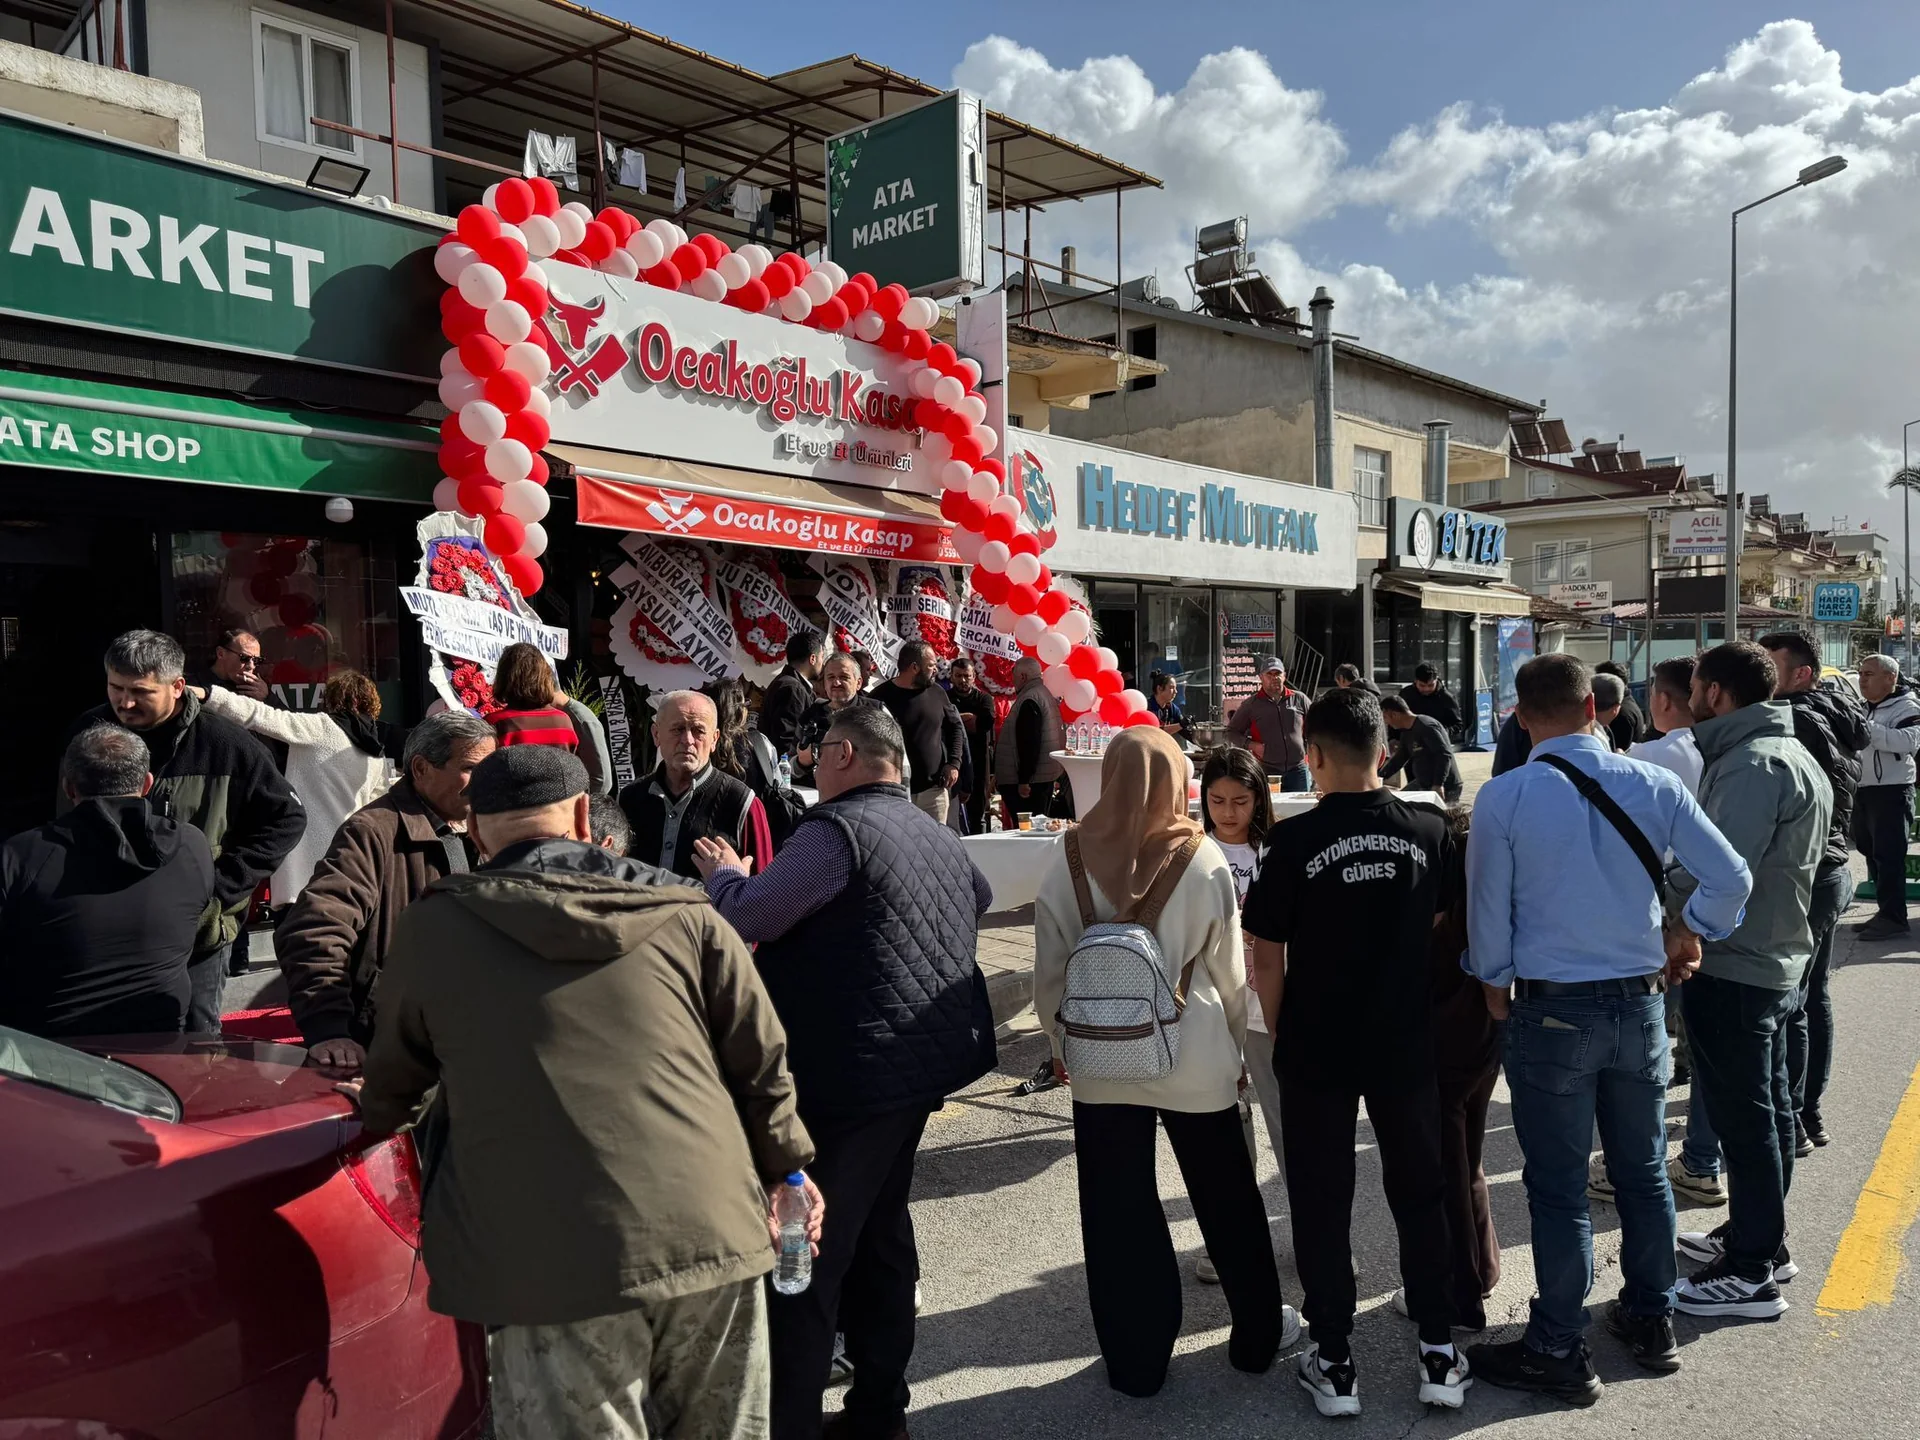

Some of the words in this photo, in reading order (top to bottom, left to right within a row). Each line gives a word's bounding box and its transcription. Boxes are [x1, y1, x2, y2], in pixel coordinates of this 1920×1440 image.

[873, 178, 915, 210] ATA
[9, 186, 325, 309] ARKET
[852, 203, 938, 249] MARKET
[638, 322, 834, 422] Ocakoğlu
[840, 369, 924, 450] Kasa
[0, 416, 79, 452] ATA
[91, 427, 201, 464] SHOP
[785, 432, 802, 453] Et
[809, 441, 827, 457] ve
[833, 442, 849, 461] Et
[855, 441, 913, 471] Ürünleri
[713, 503, 838, 541] Ocakoğlu
[844, 521, 914, 551] Kasap
[1083, 461, 1196, 539] HEDEF
[1204, 482, 1319, 553] MUTFAK
[1691, 514, 1723, 527] ACİL
[817, 540, 828, 549] Et
[829, 543, 842, 551] ve
[843, 543, 853, 552] Et
[853, 544, 895, 557] Ürünleri
[621, 579, 684, 637] AYSUN
[696, 597, 734, 648] TEMEL
[824, 597, 866, 635] AHMET
[887, 596, 911, 611] SMM
[960, 627, 1001, 647] ERCAN
[1305, 834, 1428, 879] SEYDİKEMERSPOR
[1342, 861, 1397, 884] GÜREŞ
